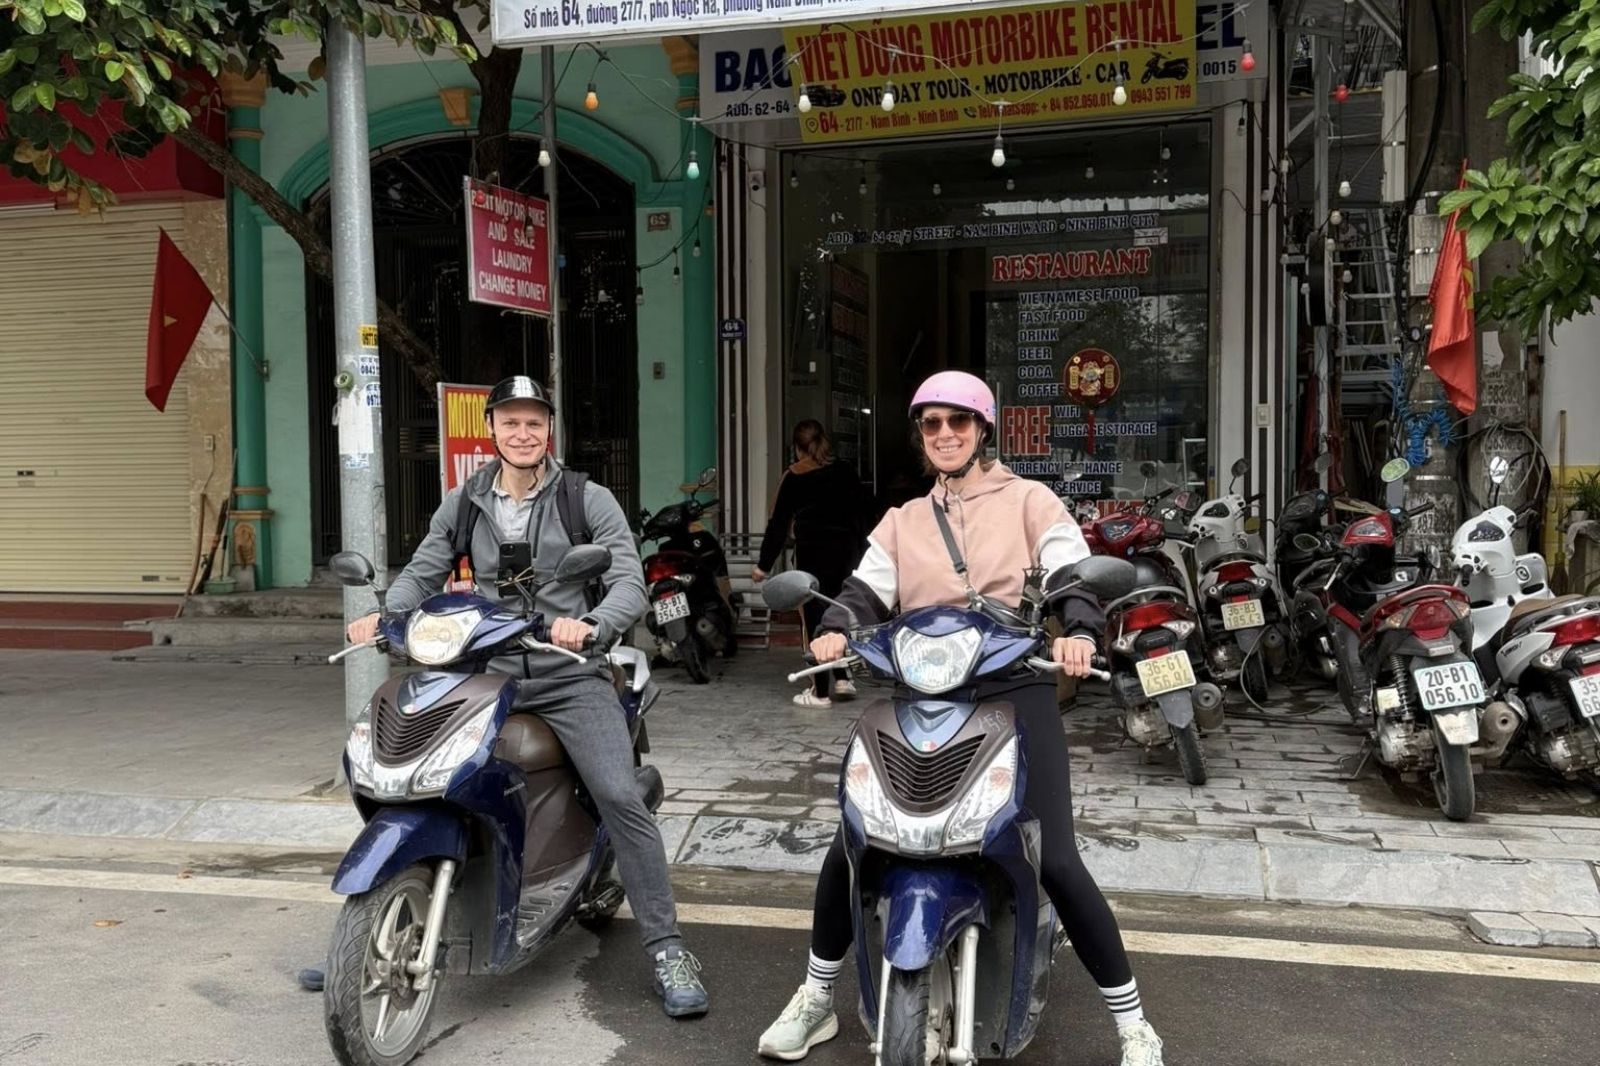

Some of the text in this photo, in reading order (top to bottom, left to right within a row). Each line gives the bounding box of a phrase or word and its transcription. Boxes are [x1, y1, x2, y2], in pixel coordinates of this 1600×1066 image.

[524, 5, 537, 29] Số
[540, 7, 559, 27] nhà
[929, 7, 1080, 70] MOTORBIKE
[1085, 0, 1184, 57] RENTAL
[1203, 60, 1237, 76] 0015
[851, 60, 1131, 107] ONE DAY TOUR MOTORBIKE CAR
[819, 111, 839, 134] 64
[1154, 85, 1172, 102] 551
[1174, 83, 1192, 100] 799
[487, 220, 536, 250] AND SALE
[912, 225, 956, 241] STREET
[963, 224, 989, 240] NAM
[990, 221, 1019, 238] BINH
[1021, 218, 1057, 235] WARD
[1066, 215, 1099, 233] NINH
[1099, 214, 1129, 231] BINH
[1130, 212, 1160, 230] CITY
[491, 246, 533, 274] LAUNDRY
[992, 247, 1152, 282] RESTAURANT
[478, 269, 547, 303] CHANGE MONEY
[1018, 286, 1140, 305] VIETNAMESE FOOD
[1018, 308, 1087, 325] FAST FOOD
[1018, 328, 1059, 342] DRINK
[1018, 347, 1052, 361] BEER
[1018, 365, 1053, 379] COCA
[1054, 405, 1080, 418] WIFI
[1002, 405, 1051, 456] FREE
[1105, 421, 1158, 437] STORAGE
[1055, 480, 1101, 495] SERVICE
[1425, 666, 1469, 688] 20-B1
[1425, 683, 1479, 706] 056.10
